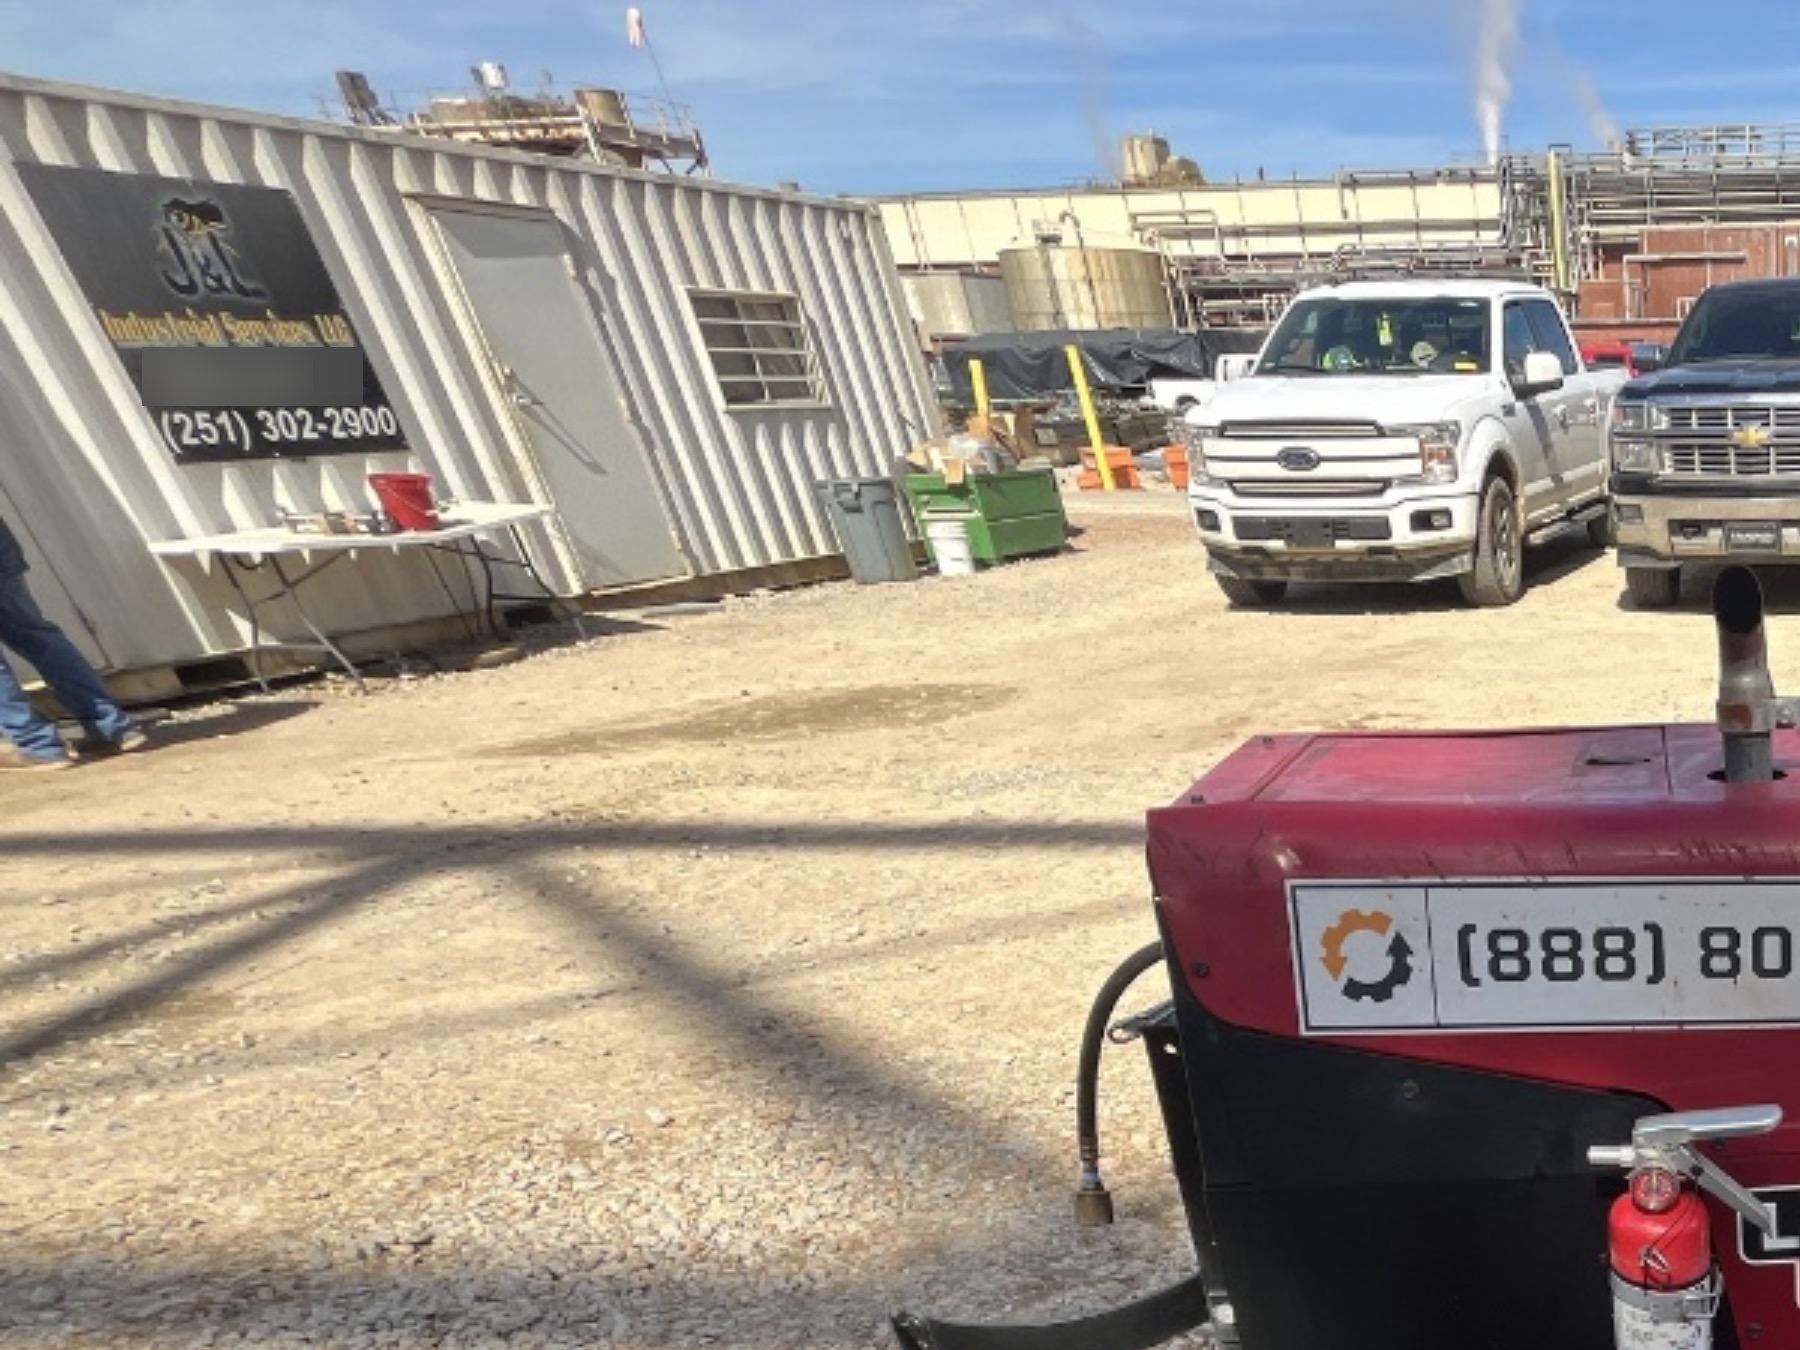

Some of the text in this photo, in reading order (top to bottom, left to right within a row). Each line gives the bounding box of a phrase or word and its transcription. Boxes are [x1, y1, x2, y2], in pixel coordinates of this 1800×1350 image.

[160, 406, 397, 455] (251) 302-2900
[1456, 922, 1667, 987] (888)
